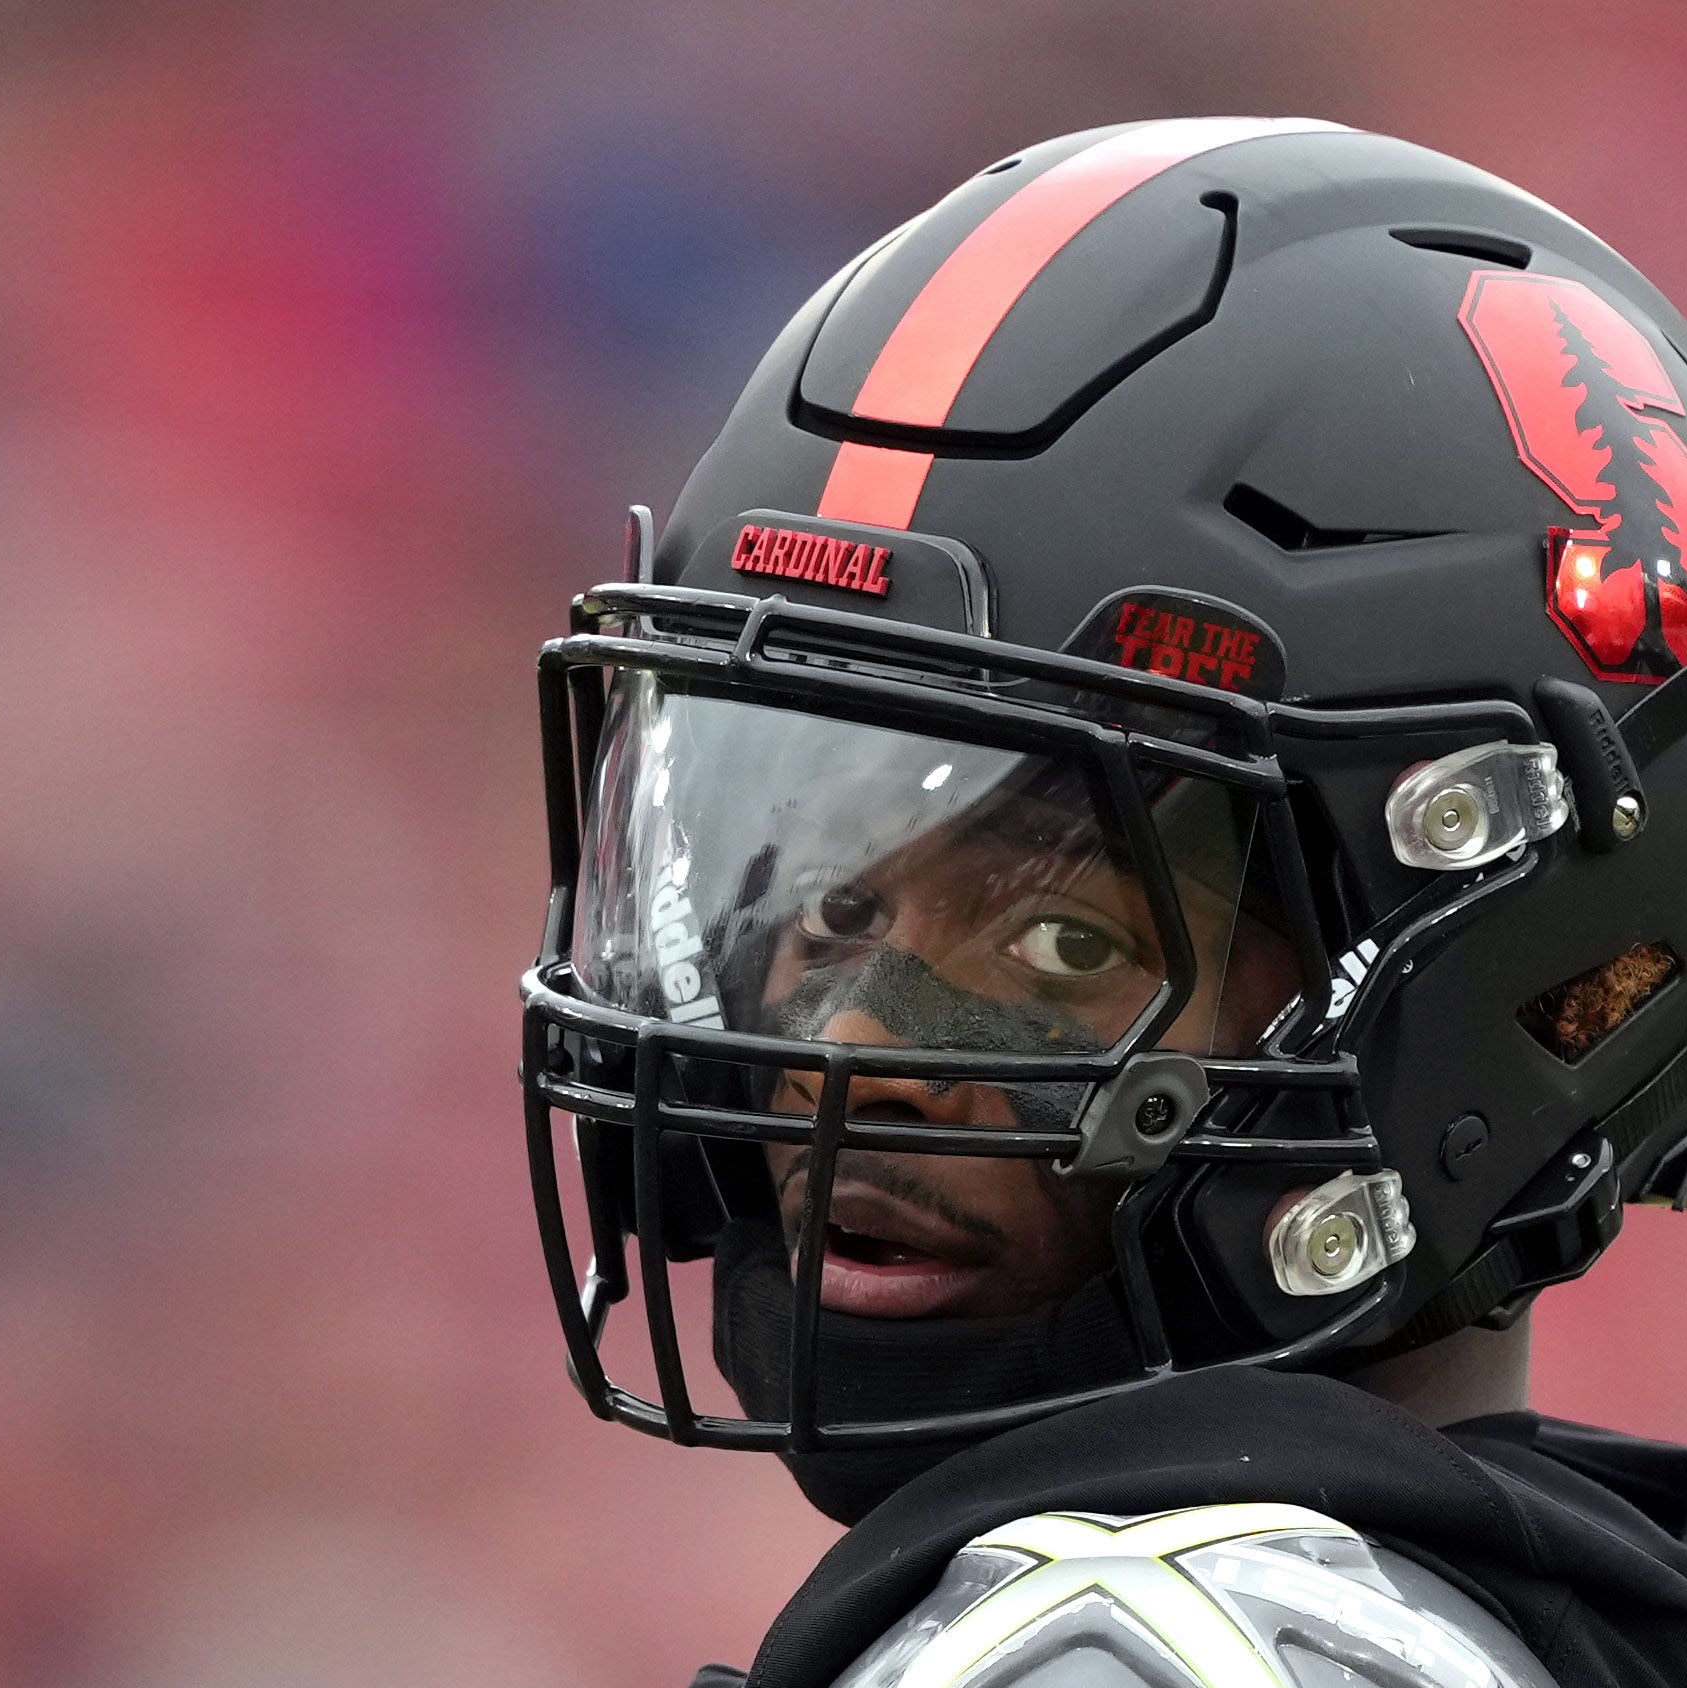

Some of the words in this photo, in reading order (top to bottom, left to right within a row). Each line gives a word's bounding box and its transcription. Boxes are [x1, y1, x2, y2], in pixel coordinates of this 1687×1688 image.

[731, 524, 892, 596] CARDINAL
[1116, 602, 1195, 649] FEAR
[1201, 622, 1261, 665] THE
[1521, 757, 1552, 833] Riddell
[650, 822, 726, 1031] iddel
